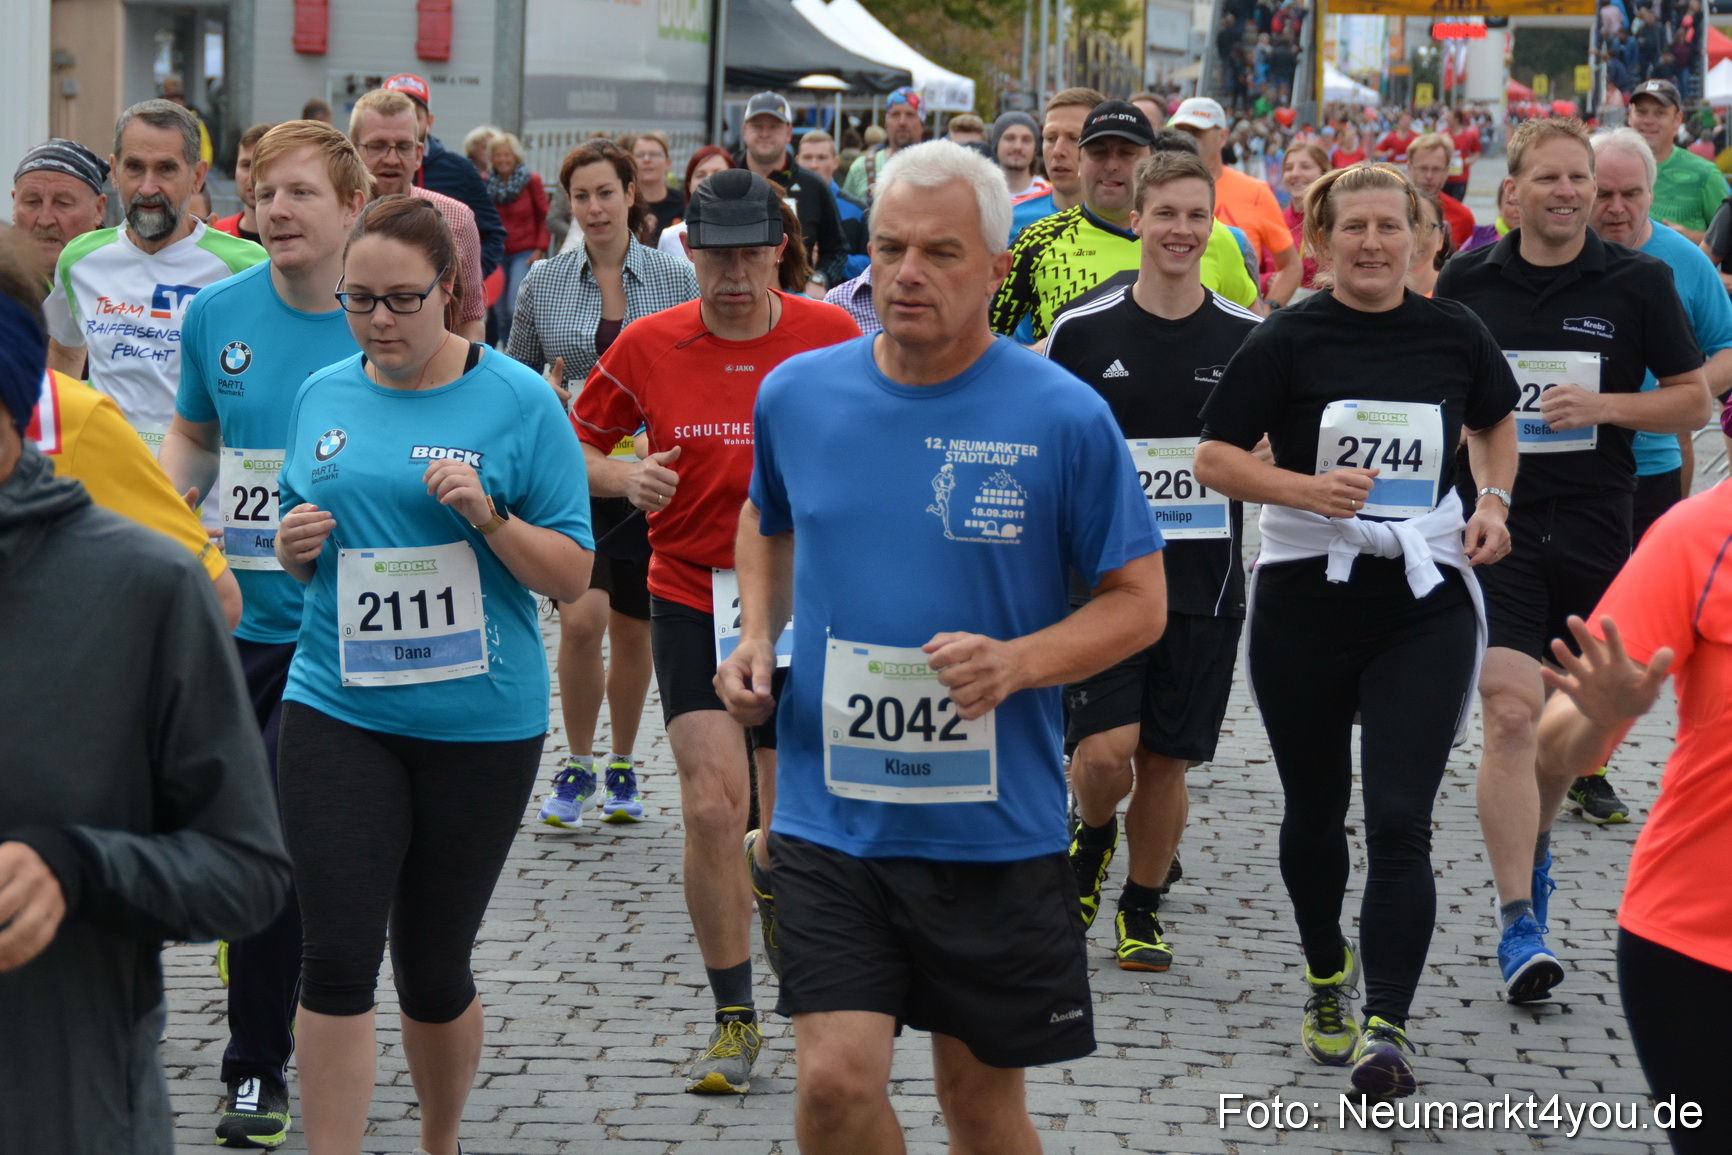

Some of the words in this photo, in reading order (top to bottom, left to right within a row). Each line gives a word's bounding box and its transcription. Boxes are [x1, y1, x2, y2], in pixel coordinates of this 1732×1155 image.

[1119, 113, 1137, 124] DTM
[96, 297, 144, 318] TEAM
[86, 320, 181, 341] RAIFFEISENB
[1583, 320, 1606, 331] Krebs
[111, 343, 176, 362] FEUCHT
[224, 342, 251, 356] BMW
[1528, 360, 1568, 371] BOCK
[1102, 370, 1129, 378] adidas
[217, 379, 245, 390] PARTL
[217, 388, 244, 397] Neumarkt
[1368, 411, 1408, 423] BOCK
[320, 429, 346, 442] BMW
[674, 423, 755, 439] SCHULTHE
[925, 437, 946, 449] 12.
[949, 439, 1038, 457] NEUMARKTER
[1158, 447, 1196, 457] BOCK
[1336, 436, 1423, 472] 2744
[409, 445, 485, 470] BOCK
[945, 450, 1019, 466] STADTLAUF
[311, 464, 339, 478] PARTL
[971, 507, 1025, 519] 18.09.2011
[1155, 511, 1192, 523] Philipp
[387, 559, 438, 573] BOCK
[358, 586, 455, 632] 2111
[394, 646, 432, 660] Dana
[848, 694, 968, 742] 2042
[885, 758, 932, 776] Klaus
